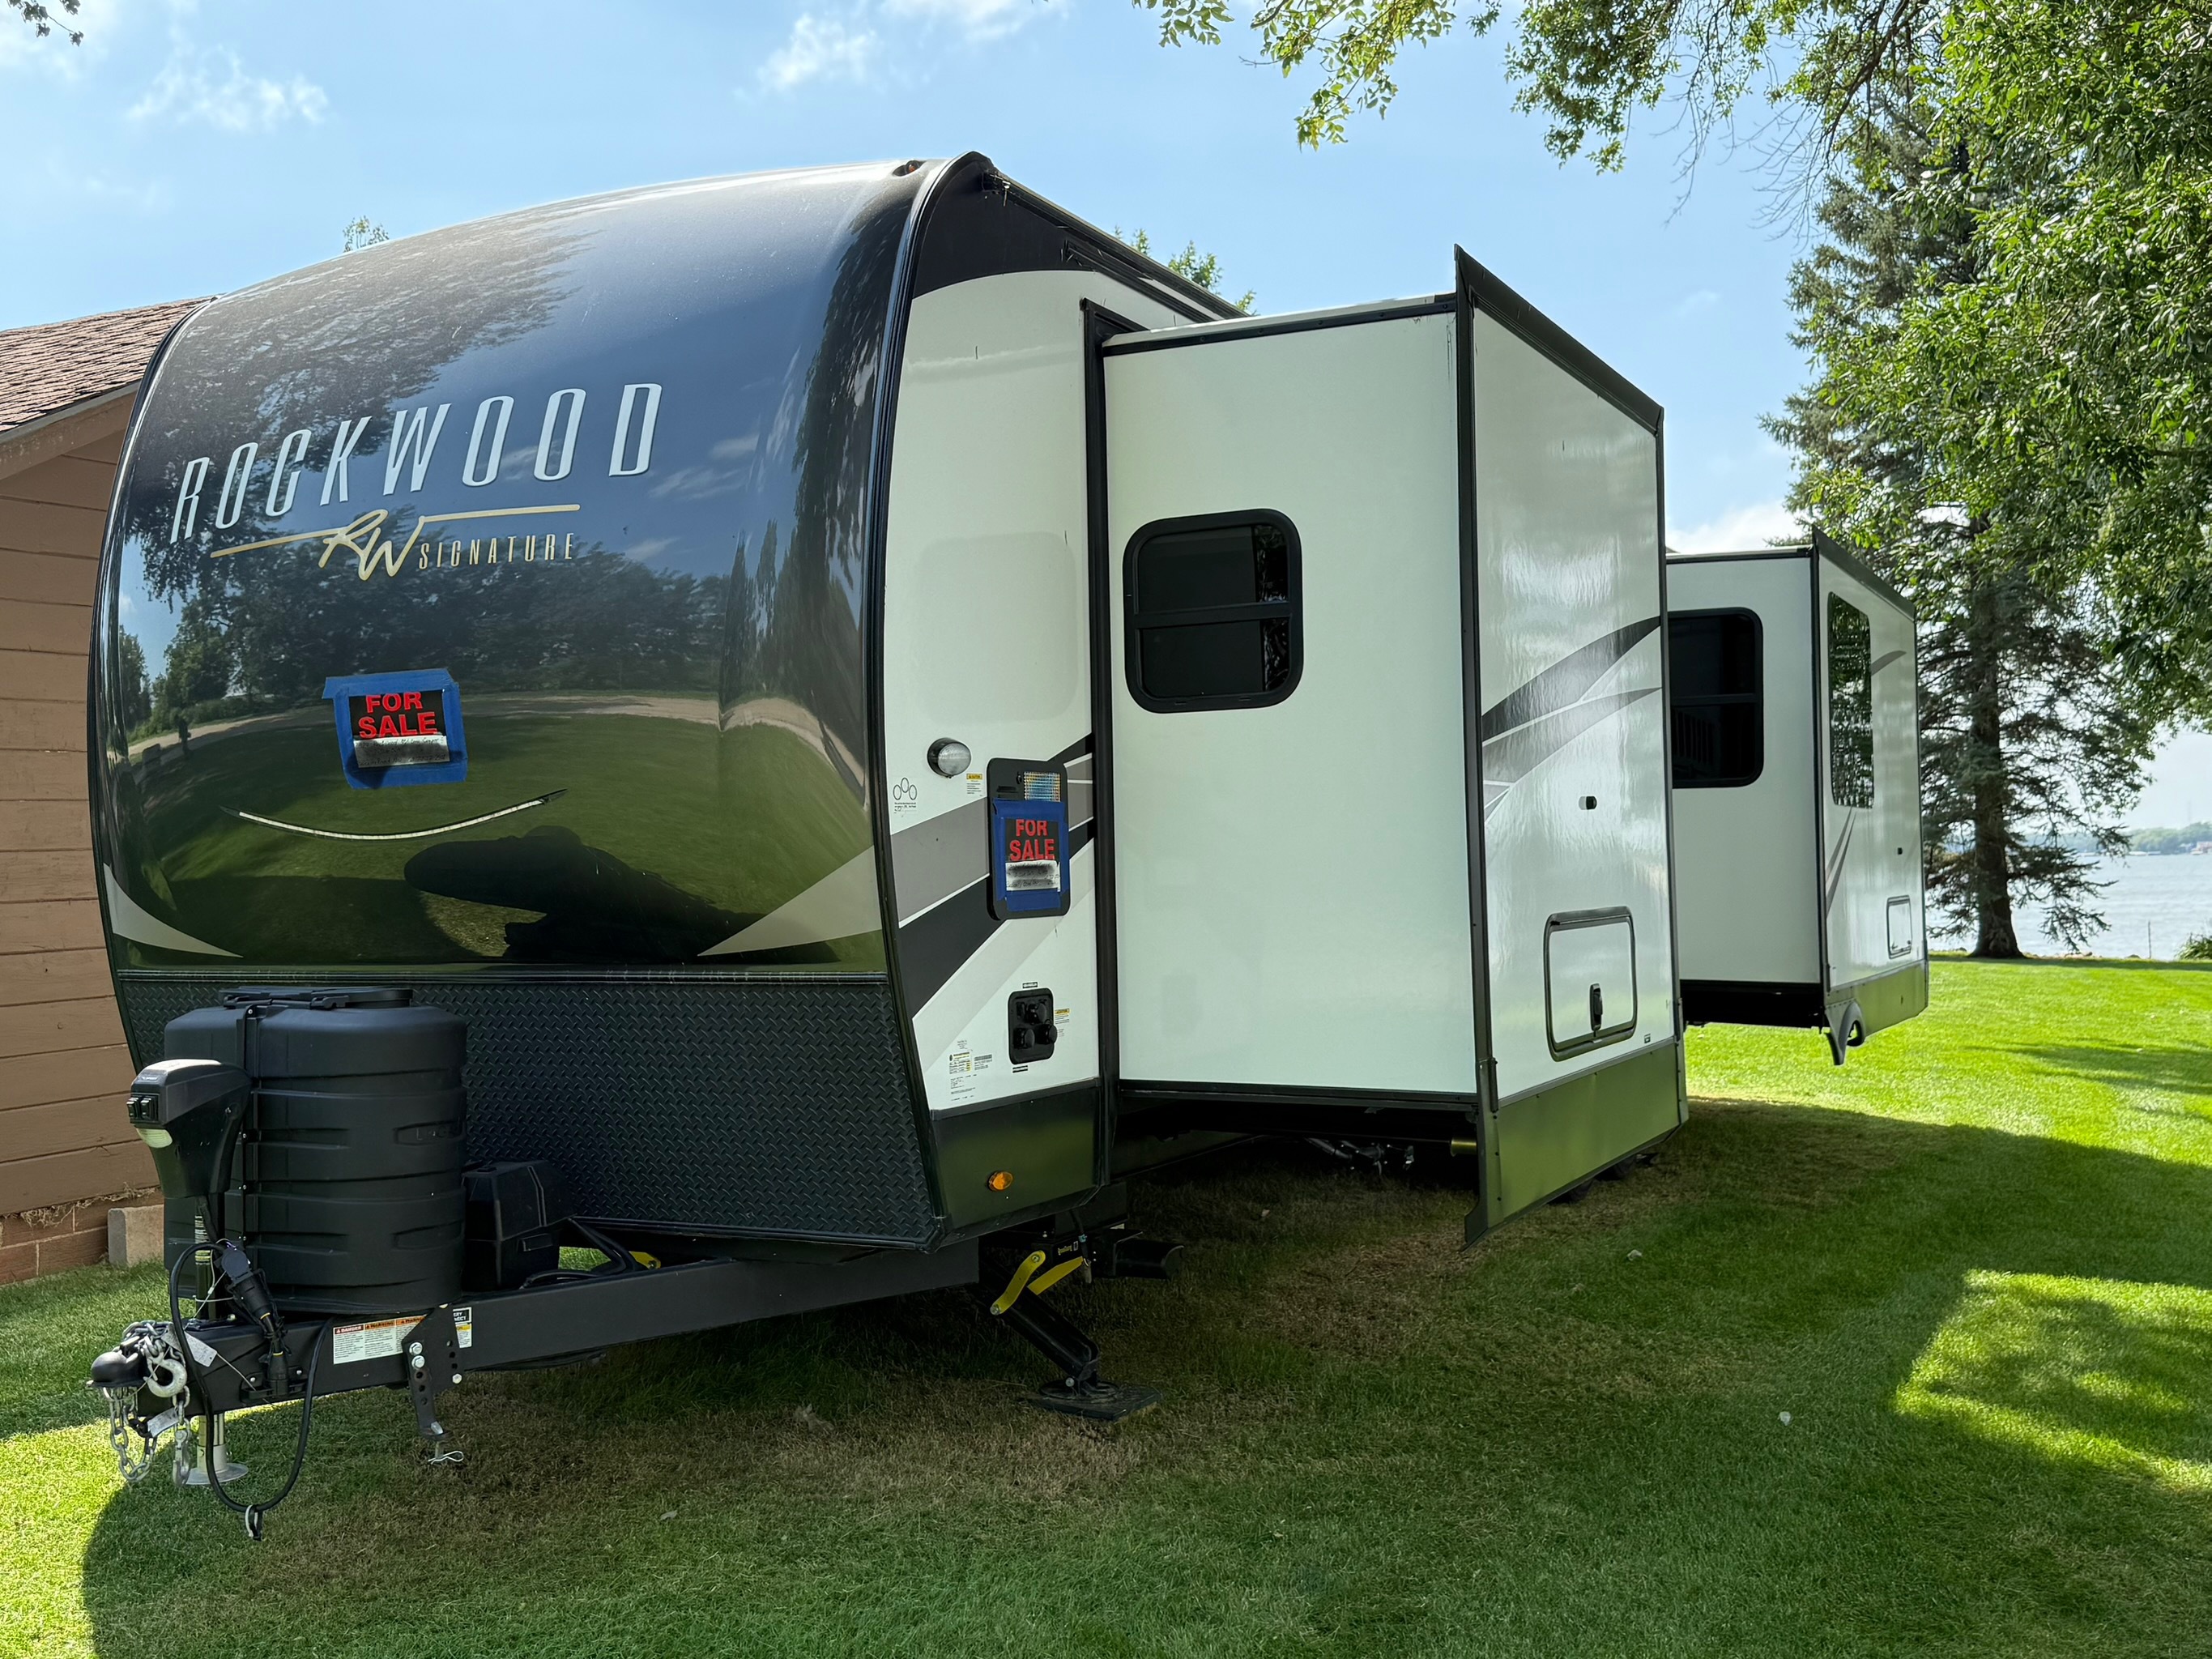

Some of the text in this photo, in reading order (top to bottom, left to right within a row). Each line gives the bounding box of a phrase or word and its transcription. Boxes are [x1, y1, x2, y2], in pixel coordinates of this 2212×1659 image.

[170, 383, 663, 544] ROCKWOOD
[419, 533, 573, 569] SIGNATURE
[365, 692, 424, 714] FOR
[358, 711, 438, 740] SALE
[1016, 819, 1049, 837] FOR
[1009, 838, 1056, 862] SALE
